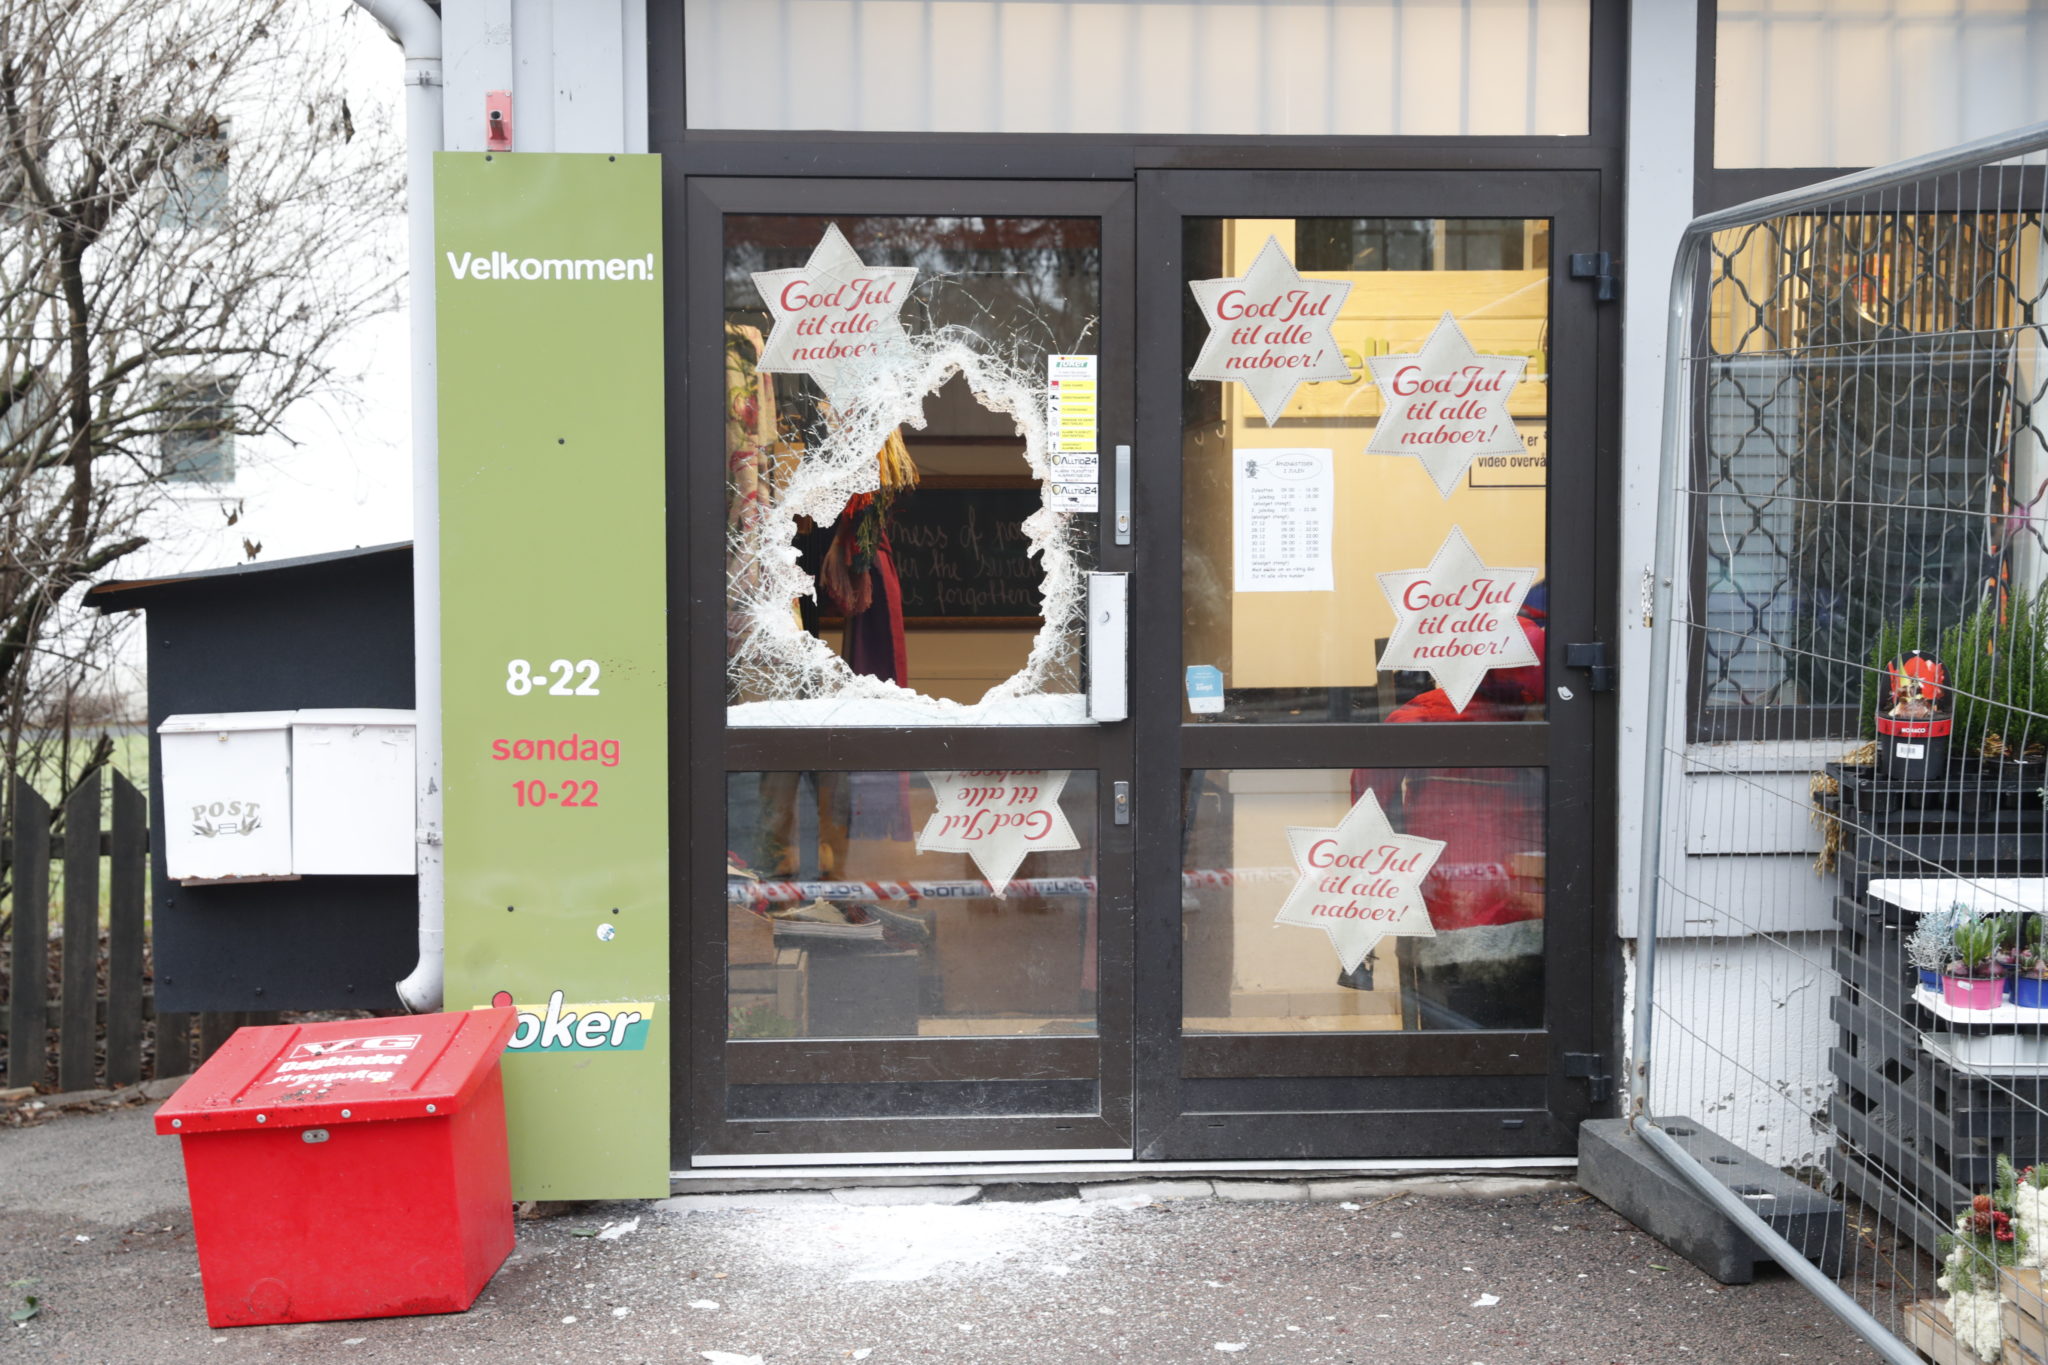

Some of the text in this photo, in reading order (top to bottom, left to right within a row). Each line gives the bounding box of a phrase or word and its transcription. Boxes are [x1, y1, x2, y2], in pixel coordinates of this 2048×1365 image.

[446, 251, 654, 280] Velkommen!
[780, 278, 896, 311] God Jul
[1217, 290, 1331, 322] God Jul
[796, 314, 827, 336] til
[1231, 325, 1312, 345] til alle
[1226, 349, 1323, 369] naboer!
[1392, 365, 1506, 398] God Jul
[1406, 400, 1487, 420] til alle
[1401, 424, 1498, 444] naboer!
[1527, 436, 1538, 447] er
[1478, 452, 1547, 467] video overvå
[937, 579, 1040, 615] forgotten
[1403, 578, 1516, 611] God Jul
[1418, 612, 1498, 635] til alle
[1413, 636, 1510, 659] naboer!
[506, 659, 600, 696] 8-22
[491, 733, 621, 767] søndag
[512, 779, 599, 807] 10-22
[957, 786, 1039, 807] til alle
[191, 800, 260, 821] POST
[938, 808, 1053, 841] God Jul
[1307, 839, 1422, 875] God Jul
[1318, 875, 1399, 899] til alle
[1311, 900, 1408, 922] naboer!
[491, 990, 642, 1049] oker
[303, 1037, 416, 1054] VG
[276, 1054, 407, 1073] Dagbladet
